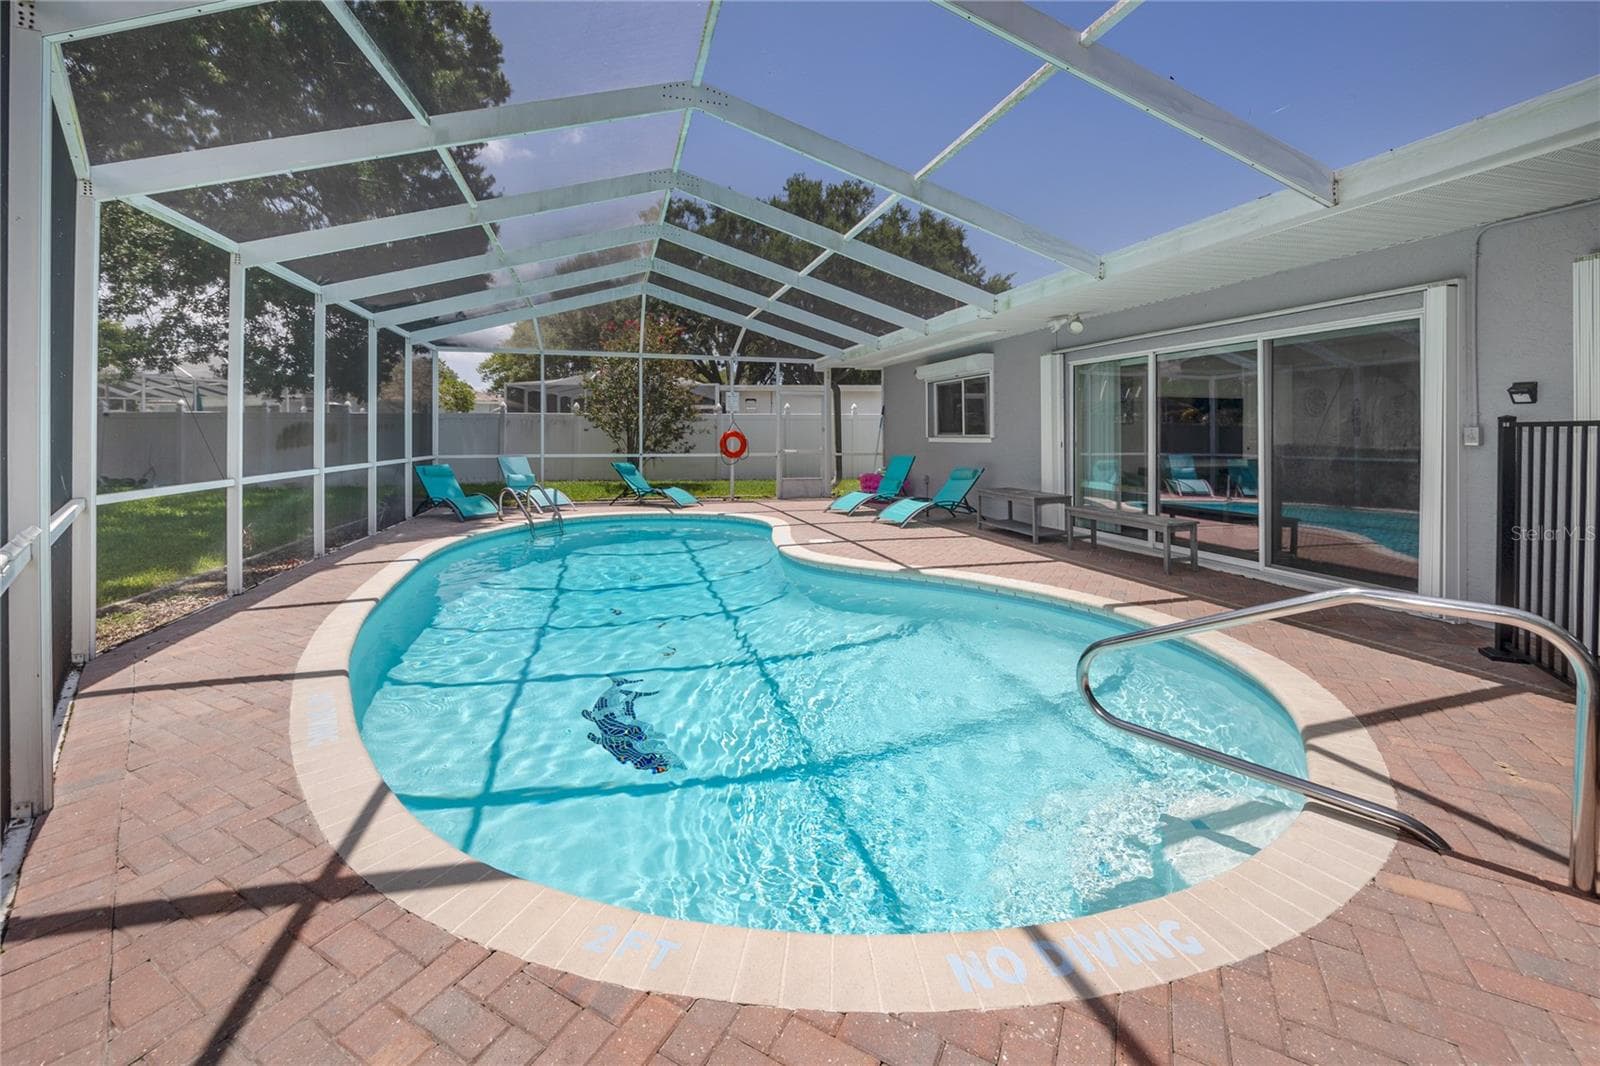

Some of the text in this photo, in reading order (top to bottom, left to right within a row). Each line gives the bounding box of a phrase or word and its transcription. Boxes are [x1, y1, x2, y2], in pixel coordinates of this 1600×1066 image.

[581, 924, 681, 971] 2FT
[946, 919, 1202, 992] NO DIVING
